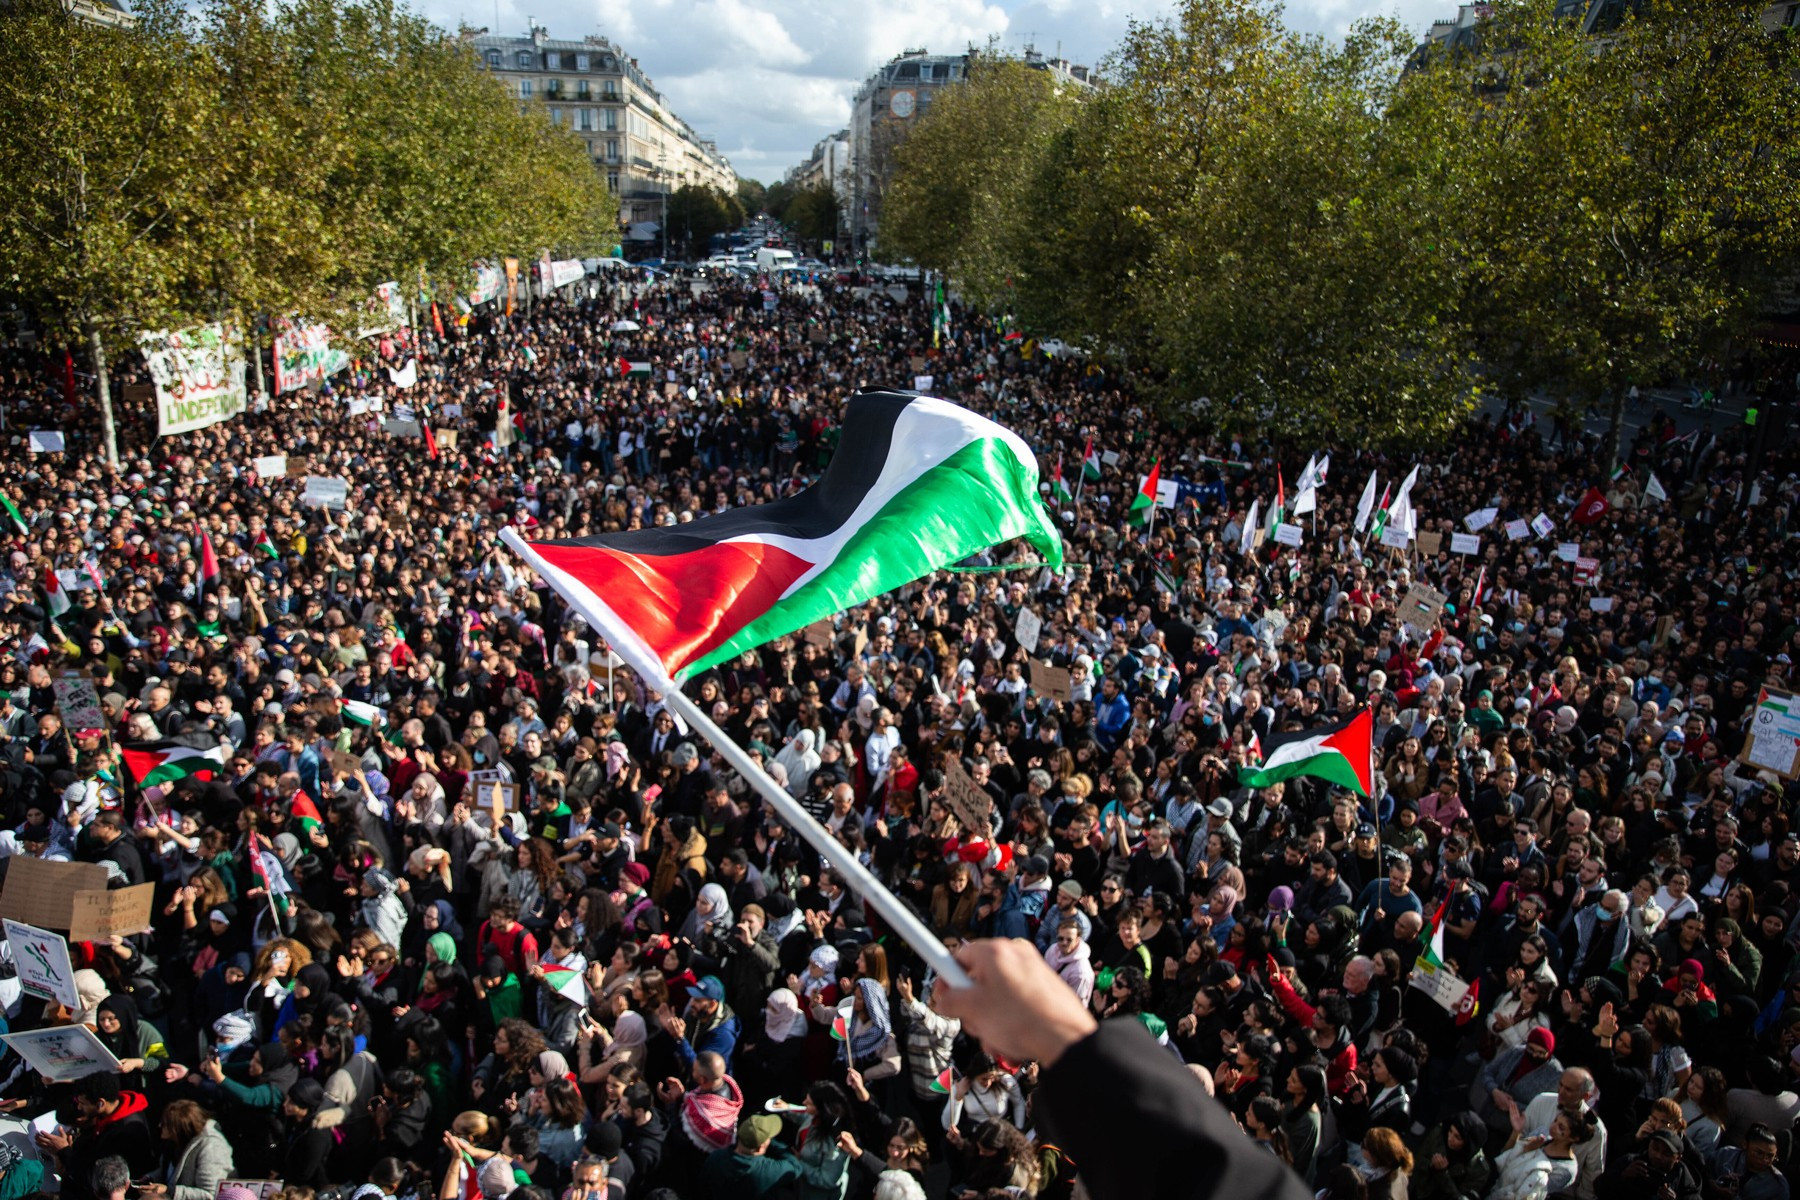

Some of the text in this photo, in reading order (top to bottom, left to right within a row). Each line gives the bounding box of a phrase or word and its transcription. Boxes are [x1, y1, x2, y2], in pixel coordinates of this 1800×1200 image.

[1753, 725, 1793, 745] SALAM
[954, 771, 985, 807] STOP
[88, 895, 100, 906] IL
[27, 1034, 65, 1044] GAZA
